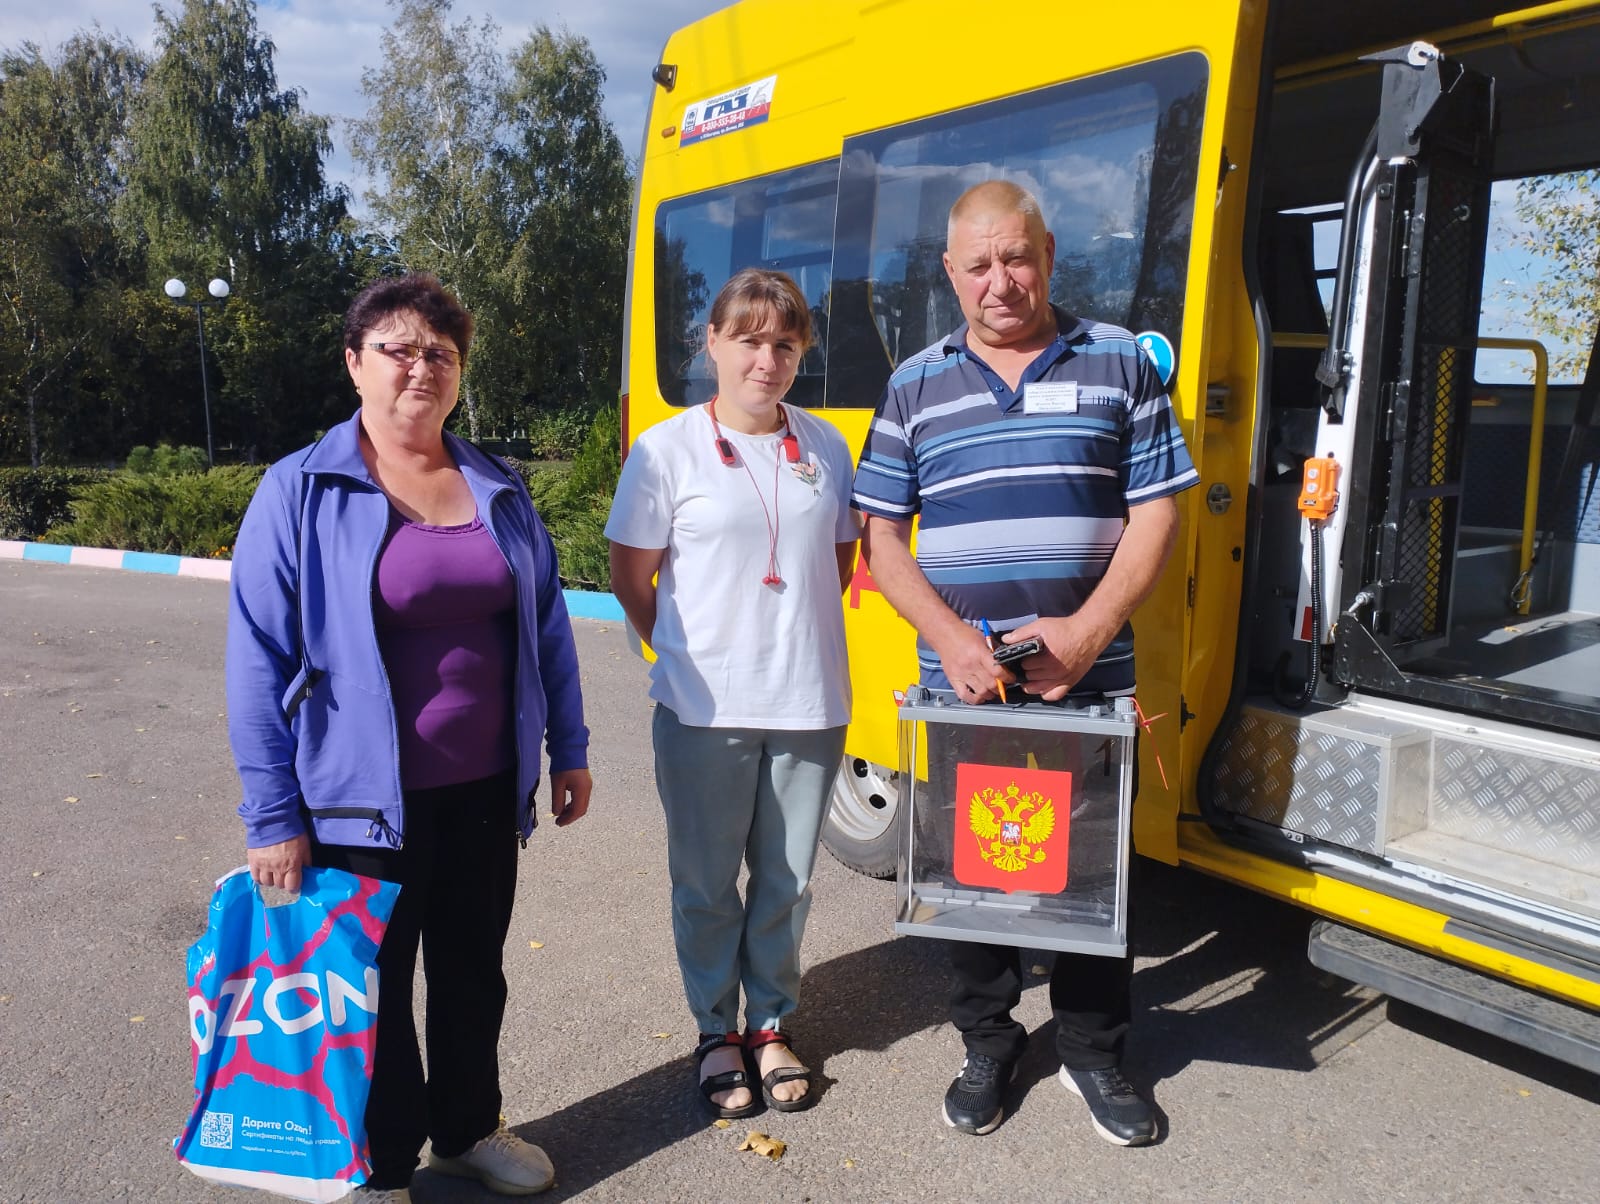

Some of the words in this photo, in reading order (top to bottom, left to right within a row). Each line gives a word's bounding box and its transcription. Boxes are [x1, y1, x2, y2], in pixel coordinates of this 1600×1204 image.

[703, 93, 749, 121] ГАЗ
[188, 966, 380, 1055] OZON
[241, 1116, 282, 1130] Дарите
[284, 1120, 313, 1136] Ozon!
[241, 1130, 285, 1142] Сертификаты
[285, 1135, 294, 1143] на
